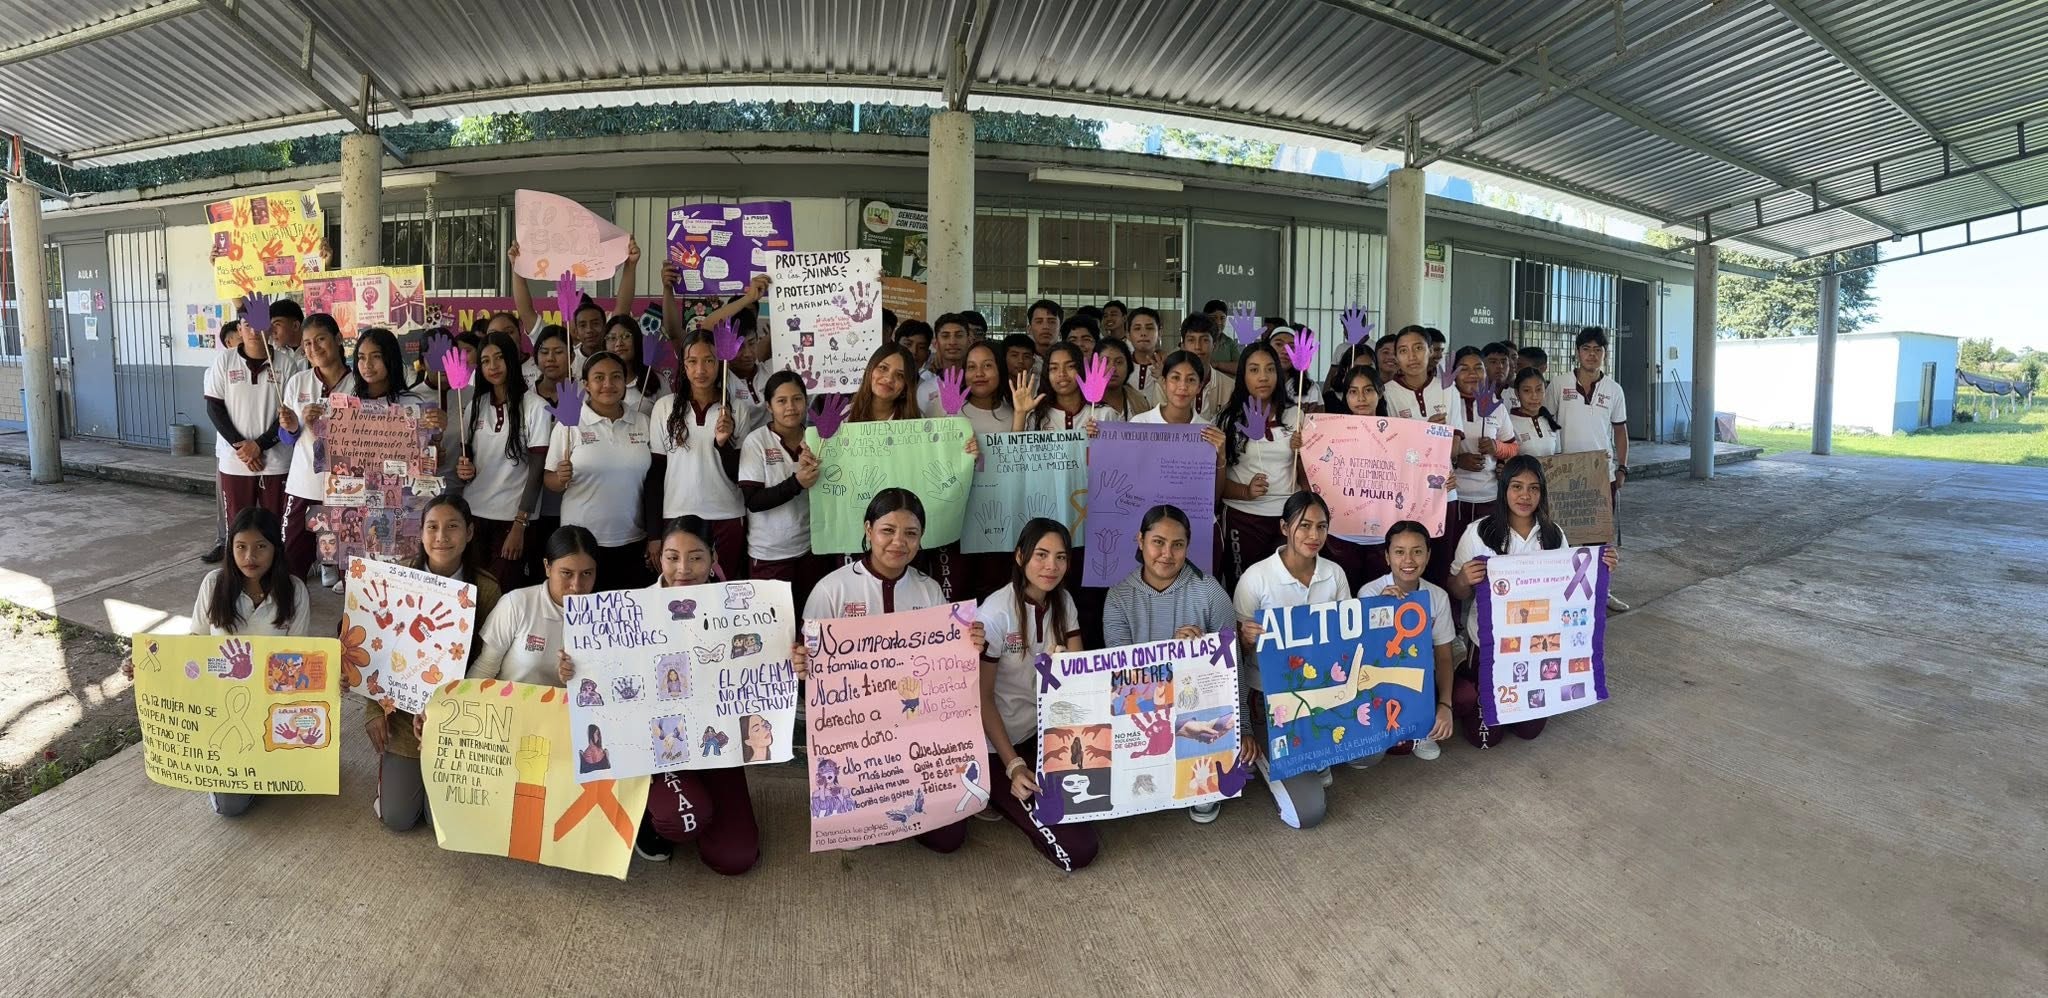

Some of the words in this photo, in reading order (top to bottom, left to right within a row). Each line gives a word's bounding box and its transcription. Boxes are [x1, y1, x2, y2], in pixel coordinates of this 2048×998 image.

[776, 251, 851, 269] PROTEJAMOS
[78, 270, 93, 279] AULA
[1217, 263, 1243, 275] AULA
[1247, 267, 1255, 276] 3
[776, 282, 844, 298] PROTEJAMOS
[1473, 306, 1491, 317] BAÑO
[1470, 317, 1494, 325] MUJERES
[330, 408, 344, 421] 25
[350, 408, 405, 423] Noviembre
[330, 423, 347, 433] Día
[352, 425, 414, 438] Internacional
[860, 420, 960, 436] INTERNACIONAL
[328, 438, 339, 446] de
[341, 438, 349, 446] la
[407, 440, 417, 448] de
[986, 433, 1003, 446] DÍA
[1008, 432, 1085, 445] INTERNACIONAL
[330, 447, 337, 455] la
[380, 451, 406, 460] contra
[410, 451, 419, 460] la
[992, 446, 1004, 455] DE
[1007, 446, 1018, 454] LA
[999, 454, 1010, 463] DE
[1013, 454, 1024, 462] LA
[1027, 452, 1069, 462] VIOLENCIA
[996, 464, 1030, 473] CONTRA
[1032, 463, 1042, 471] LA
[1046, 460, 1079, 470] MUJER
[1349, 456, 1397, 470] INTERNACIONAL
[1332, 466, 1341, 477] DE
[1346, 467, 1355, 478] LA
[822, 483, 847, 496] STOP
[1332, 477, 1341, 486] DE
[1343, 477, 1352, 487] LA
[1355, 478, 1384, 490] VIOLENCIA
[1342, 487, 1355, 497] LA
[1360, 488, 1394, 501] MUJER
[389, 566, 397, 574] 25
[568, 596, 590, 612] NO
[596, 590, 636, 610] MAS
[566, 605, 644, 626] VIOLENCIA
[733, 614, 751, 627] es
[592, 620, 643, 636] CONTRA
[1256, 598, 1363, 653] ALTO
[573, 635, 602, 650] LAS
[608, 630, 668, 649] MUJERES
[808, 622, 855, 658] No
[857, 630, 907, 653] importa
[928, 630, 945, 645] es
[946, 624, 961, 640] de
[1061, 652, 1128, 676] VIOLENCIA
[1131, 640, 1187, 667] CONTRA
[1189, 638, 1217, 658] LAS
[809, 658, 824, 674] la
[827, 655, 868, 675] familia
[870, 658, 879, 670] o
[719, 668, 735, 689] EL
[740, 663, 766, 690] QUE
[1110, 662, 1174, 687] MUJERES
[719, 688, 735, 702] NO
[737, 680, 798, 700] MALTRATA
[861, 673, 898, 697] tiene
[1498, 684, 1519, 703] 25
[142, 693, 150, 705] A
[188, 704, 202, 714] NO
[204, 706, 218, 717] SE
[716, 702, 731, 717] NI
[734, 694, 794, 714] DESTRUYE
[940, 697, 956, 709] es
[168, 715, 179, 726] NI
[181, 718, 199, 731] CON
[439, 699, 513, 742] 25N
[814, 707, 866, 731] derecho
[870, 709, 881, 721] a
[177, 732, 190, 743] DE
[437, 747, 449, 757] DE
[454, 749, 465, 759] LA
[459, 738, 510, 753] INTERNACIONAL
[207, 750, 221, 761] ES
[936, 758, 944, 767] el
[167, 757, 178, 769] DA
[181, 761, 192, 771] LA
[227, 767, 238, 777] SI
[434, 758, 446, 769] DE
[450, 760, 462, 771] LA
[466, 763, 504, 776] VIOLENCIA
[195, 776, 249, 790] DESTRUYES
[432, 771, 467, 785] CONTRA
[472, 776, 482, 787] LA
[445, 785, 491, 806] MUJER
